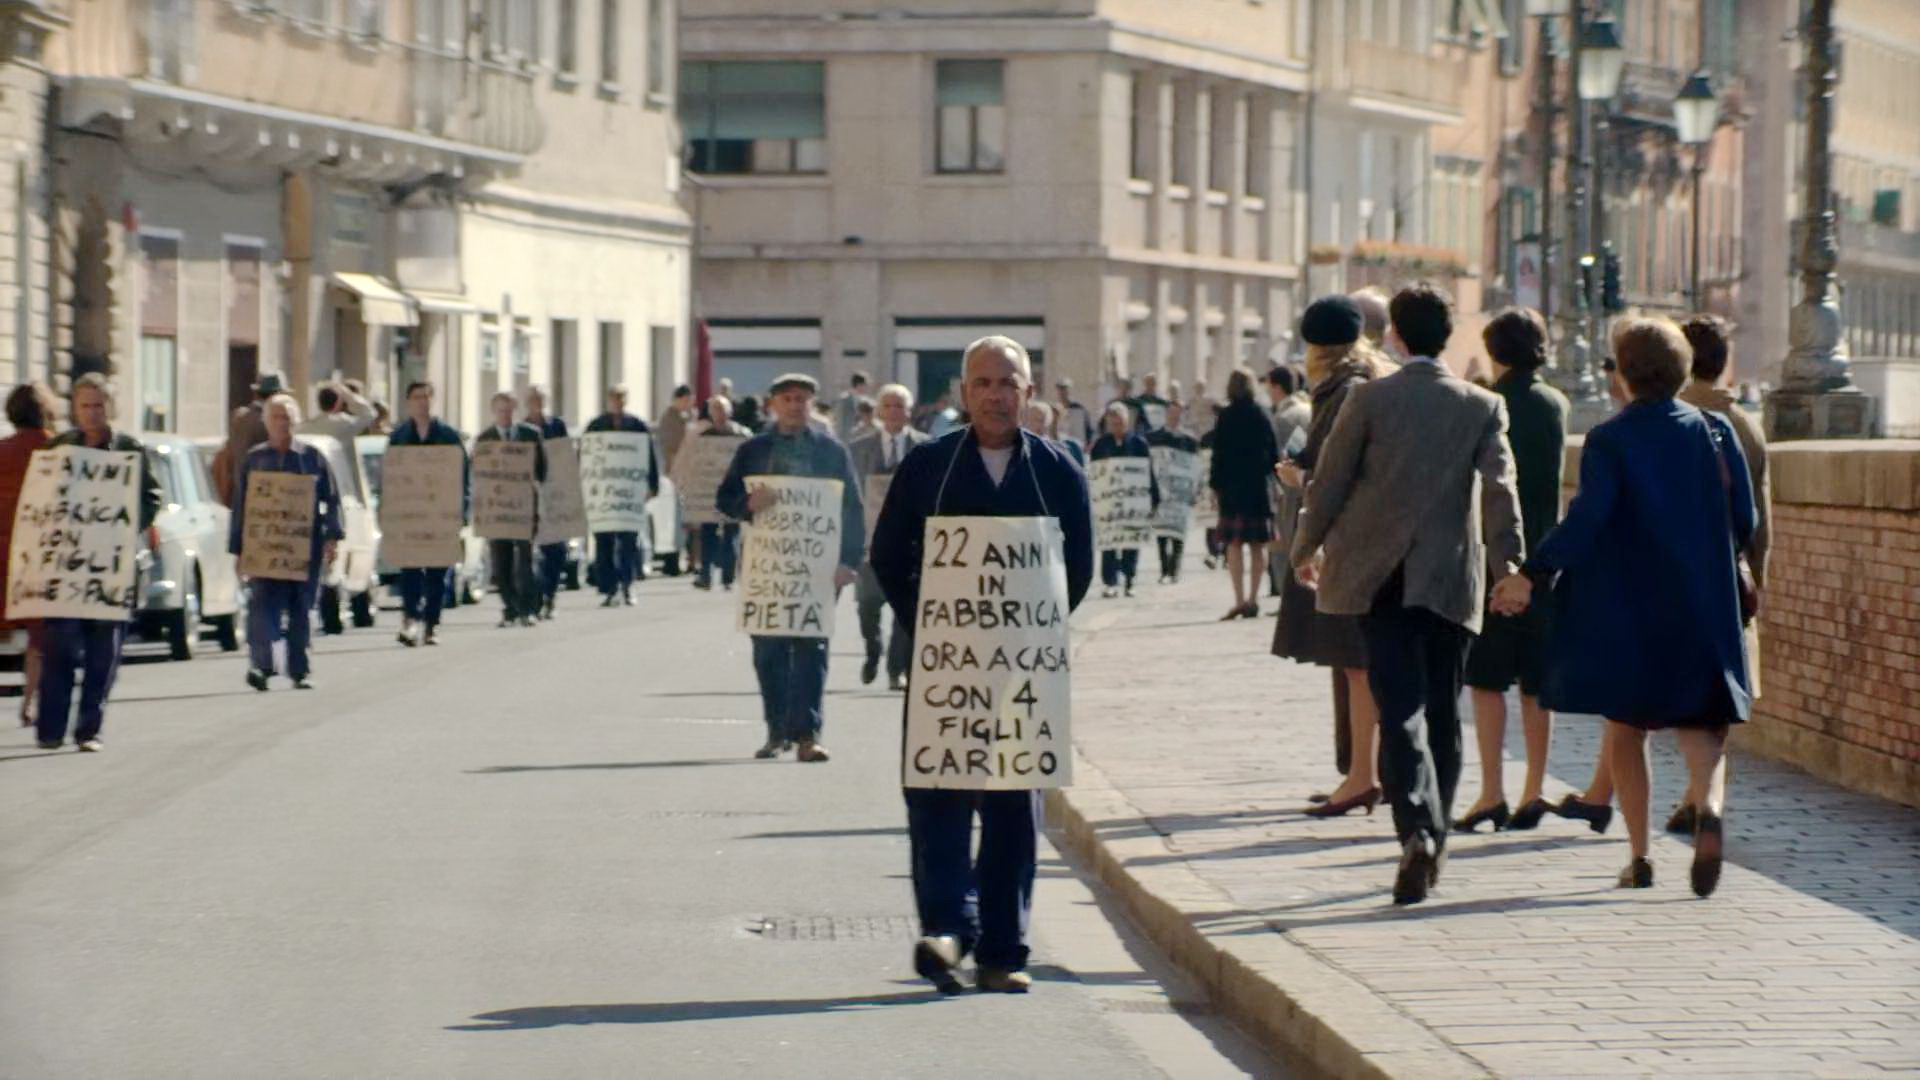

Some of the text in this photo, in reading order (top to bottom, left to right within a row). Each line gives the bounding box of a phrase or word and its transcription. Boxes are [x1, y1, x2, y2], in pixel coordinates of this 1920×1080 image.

[756, 511, 836, 536] BBRICA
[752, 536, 824, 558] MANDATO
[932, 526, 969, 569] 22
[748, 578, 812, 598] SENZA
[977, 574, 1006, 597] IN
[921, 598, 1062, 630] FABBRICA
[920, 641, 980, 672] ORA
[923, 678, 1038, 719] CON 4
[937, 716, 1053, 746] FIGLI A
[913, 746, 1058, 779] CARICO
